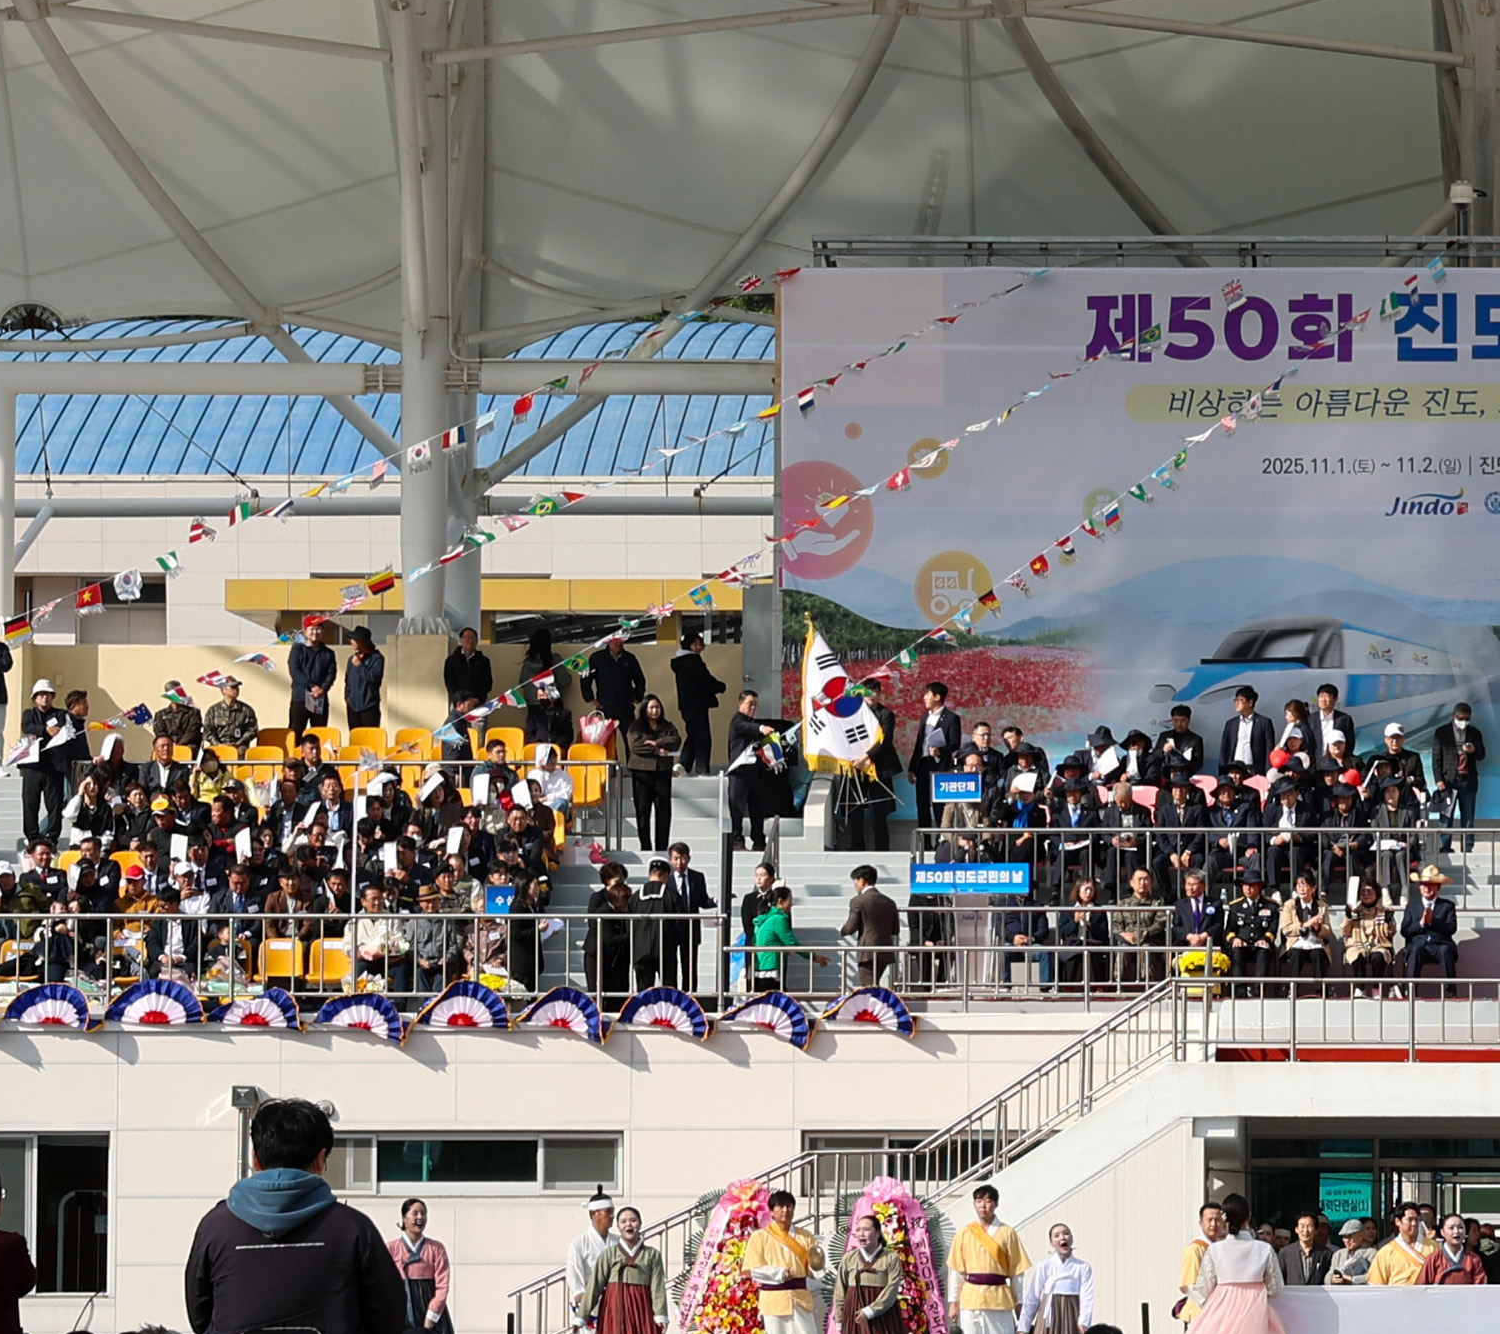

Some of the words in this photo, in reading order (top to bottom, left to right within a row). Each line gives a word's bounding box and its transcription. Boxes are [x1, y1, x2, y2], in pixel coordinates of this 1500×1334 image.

[1086, 293, 1353, 362] 제50회
[1168, 388, 1283, 418] 비상하는
[1295, 387, 1411, 418] 아름다운
[1422, 388, 1485, 419] 진도,
[1262, 457, 1375, 475] 2025.11.1.(토)
[1397, 456, 1462, 475] 11.2.(일)
[1385, 495, 1455, 517] Jindo
[939, 780, 976, 793] 기관단체
[915, 870, 953, 884] 제50회
[955, 870, 1010, 884] 진도군민의
[1012, 870, 1024, 884] 날
